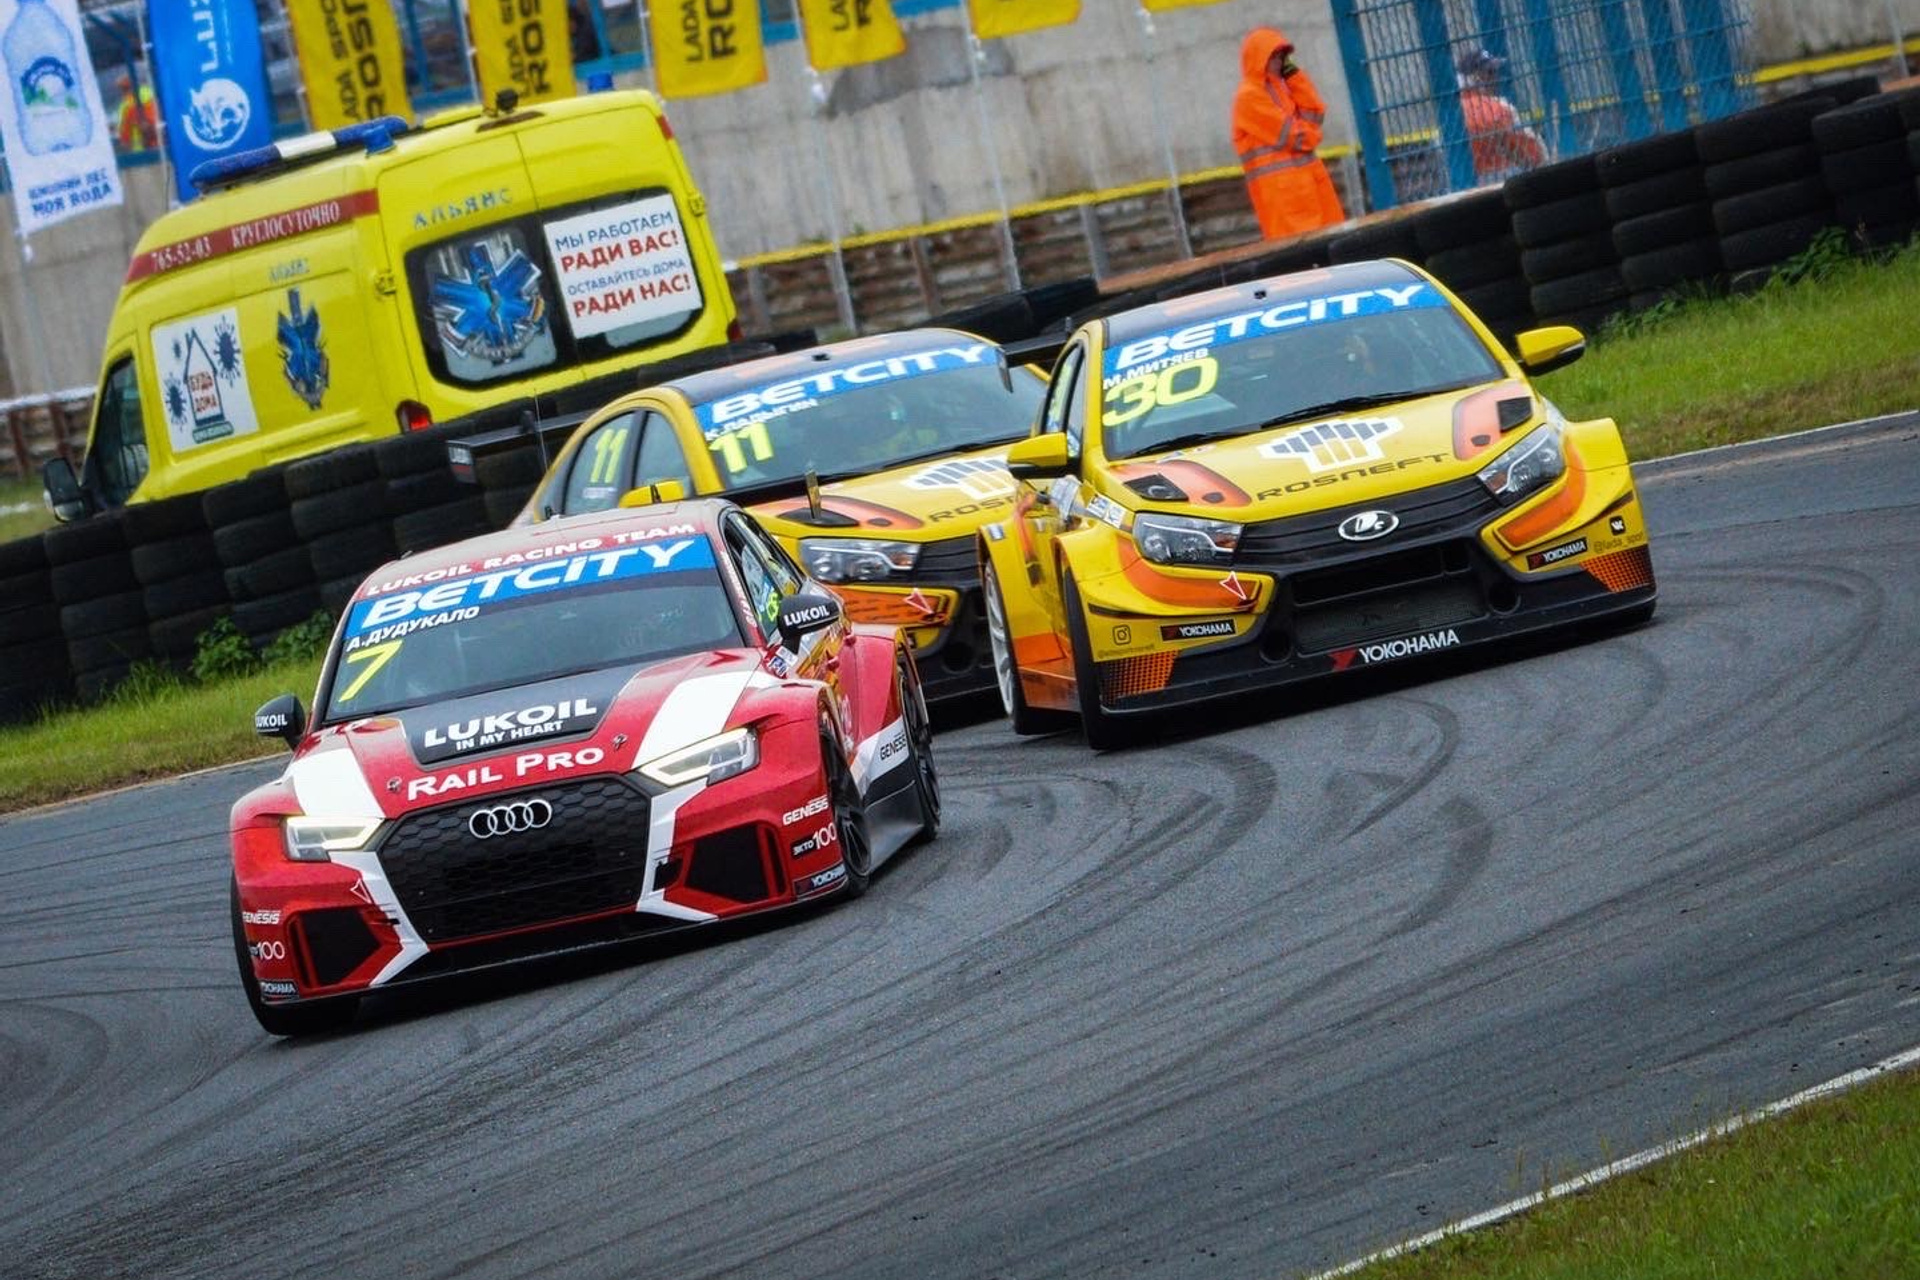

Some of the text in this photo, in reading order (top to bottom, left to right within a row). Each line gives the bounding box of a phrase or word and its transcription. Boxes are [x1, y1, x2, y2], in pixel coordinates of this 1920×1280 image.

[231, 200, 341, 249] КРУГЛОСУТОЧНО
[555, 211, 674, 251] МЫ РАБОТАЕМ
[561, 230, 679, 273] РАДИ ВАС!
[567, 258, 686, 296] ОСТАВАЙТЕСЬ ДОМА
[573, 273, 691, 318] РАДИ НАС!
[1115, 284, 1426, 371] BETCITY
[711, 346, 988, 424] BETCITY
[1102, 356, 1218, 427] 30
[590, 428, 629, 484] 11
[708, 422, 774, 474] 11
[1256, 452, 1449, 501] ROSNEFT
[366, 523, 696, 597] LUKOIL RACING TEAM
[1543, 541, 1587, 563] YOKOHAMA
[361, 539, 695, 630] BETCITY
[346, 605, 480, 652] А.ДУДУКАЛО
[783, 604, 831, 627] LUKOIL
[1178, 622, 1232, 638] YOKOHAMA
[1358, 628, 1460, 664] YOKOHAMA
[337, 639, 404, 703] 7
[424, 697, 598, 748] LUKOIL
[456, 720, 565, 751] IN MY HEART
[407, 747, 605, 801] RAIL PRO
[782, 795, 829, 826] GENESIS
[812, 821, 837, 850] 100
[257, 940, 286, 960] 100
